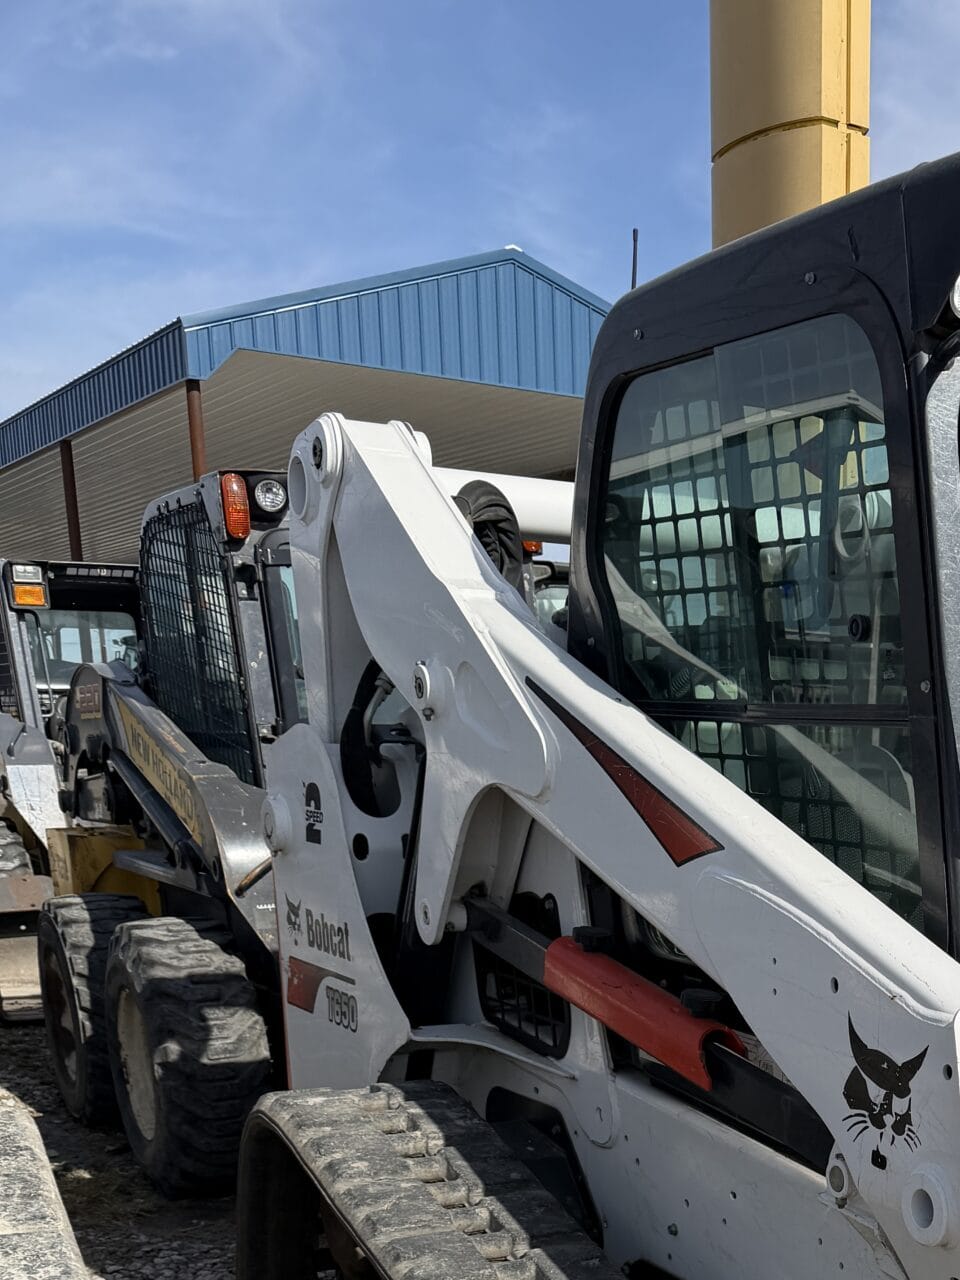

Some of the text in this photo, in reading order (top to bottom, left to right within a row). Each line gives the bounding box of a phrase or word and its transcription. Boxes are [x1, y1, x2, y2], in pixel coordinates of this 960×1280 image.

[131, 722, 150, 767] NEW
[151, 748, 195, 820] HOLLAND
[305, 809, 324, 823] SPEED
[305, 908, 351, 962] Bobcat
[326, 985, 358, 1033] T650
